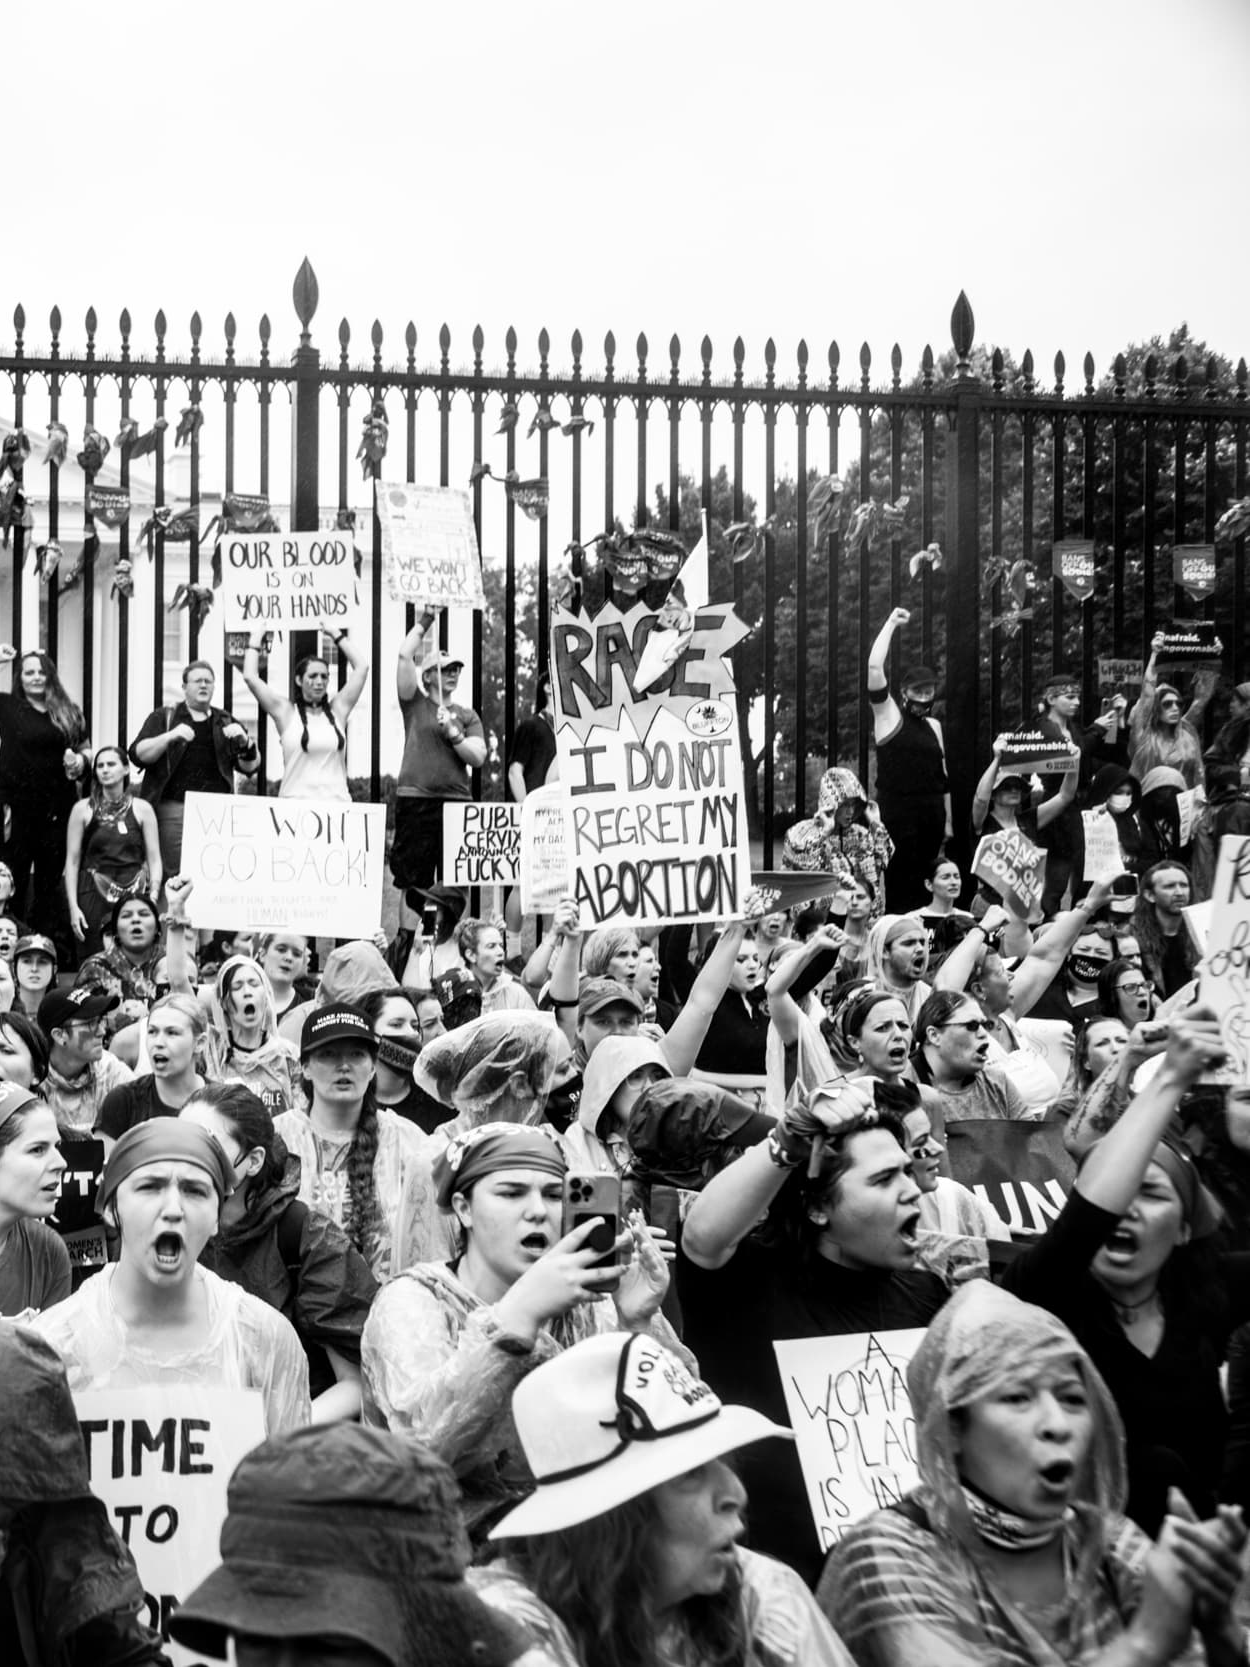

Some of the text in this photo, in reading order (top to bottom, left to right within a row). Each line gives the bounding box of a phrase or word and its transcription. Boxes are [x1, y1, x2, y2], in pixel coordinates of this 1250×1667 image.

[229, 540, 347, 569] OUR BLOOD
[397, 556, 426, 574] WE
[266, 571, 314, 588] IS ON
[399, 574, 469, 596] GO BACK
[1062, 568, 1095, 577] BODIE
[1182, 571, 1216, 581] BODIE
[236, 593, 348, 620] YOUR HANDS
[1004, 741, 1067, 753] ngovernable
[569, 738, 734, 797] I DO NOT
[196, 803, 380, 853] WE WON'T
[463, 805, 523, 833] PUBL
[572, 792, 739, 855] REGRET MY
[463, 829, 522, 849] CERVIX
[991, 838, 1023, 870] OFF
[200, 841, 368, 889] GO BACK!
[454, 856, 521, 883] FUCK Y
[574, 853, 740, 924] ABORTION
[864, 1332, 893, 1370] A
[791, 1366, 911, 1420] WOMA
[78, 1417, 214, 1484] TIME
[826, 1417, 919, 1474] PLAC
[818, 1474, 903, 1519] IS IN
[113, 1503, 179, 1546] TO
